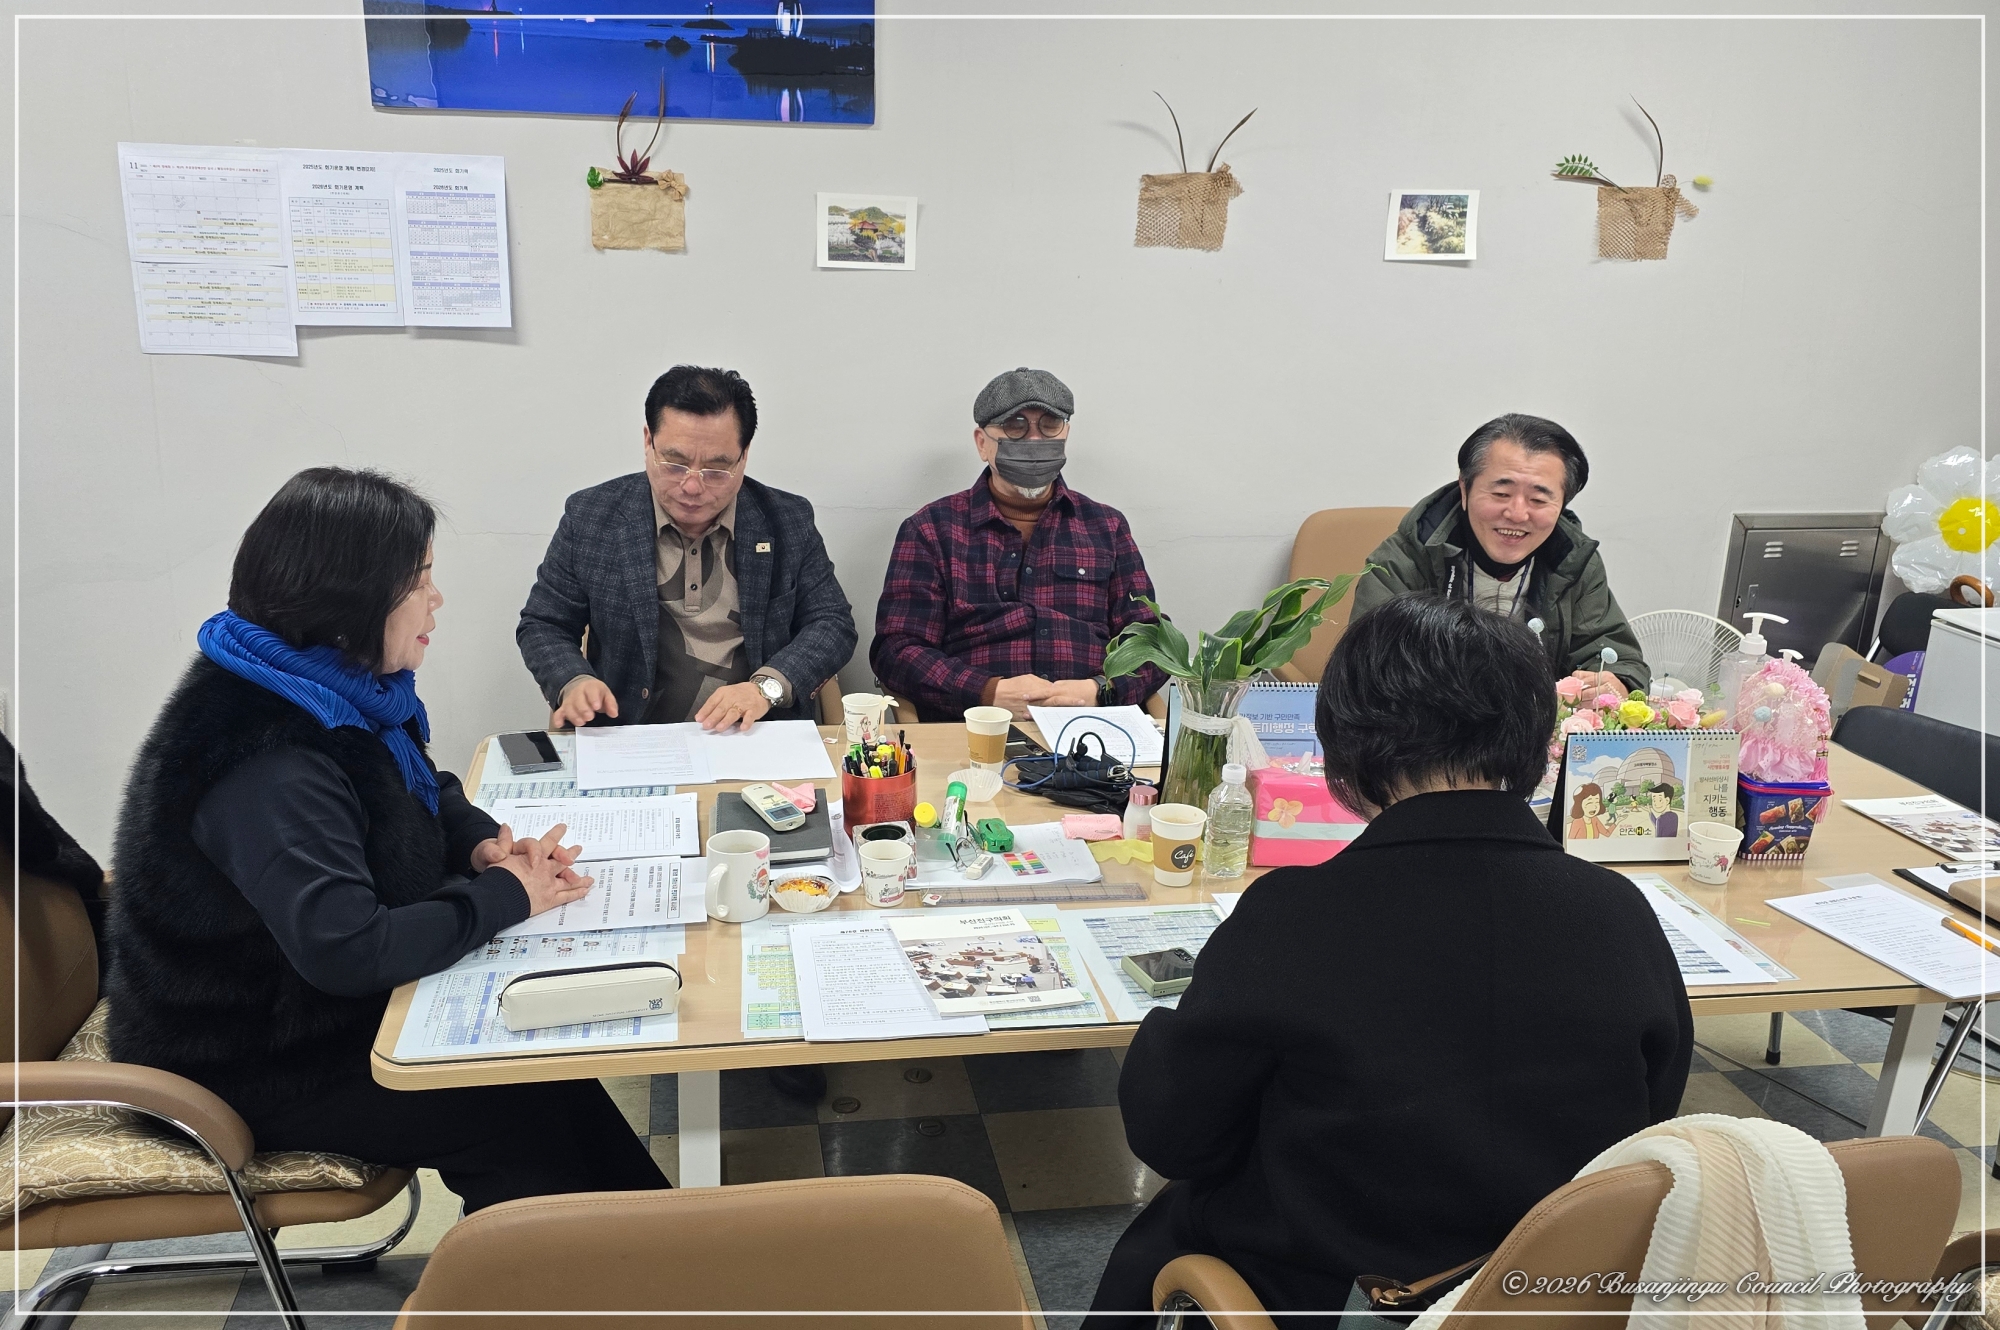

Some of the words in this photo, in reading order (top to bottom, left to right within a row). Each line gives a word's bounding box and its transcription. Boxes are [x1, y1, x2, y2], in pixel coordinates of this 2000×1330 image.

[129, 161, 138, 170] 11
[1274, 713, 1300, 721] 구민만족
[1699, 775, 1729, 783] 방사선비상시
[1713, 784, 1728, 793] 나를
[1703, 794, 1728, 805] 지키는
[1708, 806, 1727, 818] 행동
[959, 915, 1011, 925] 부산진구의회
